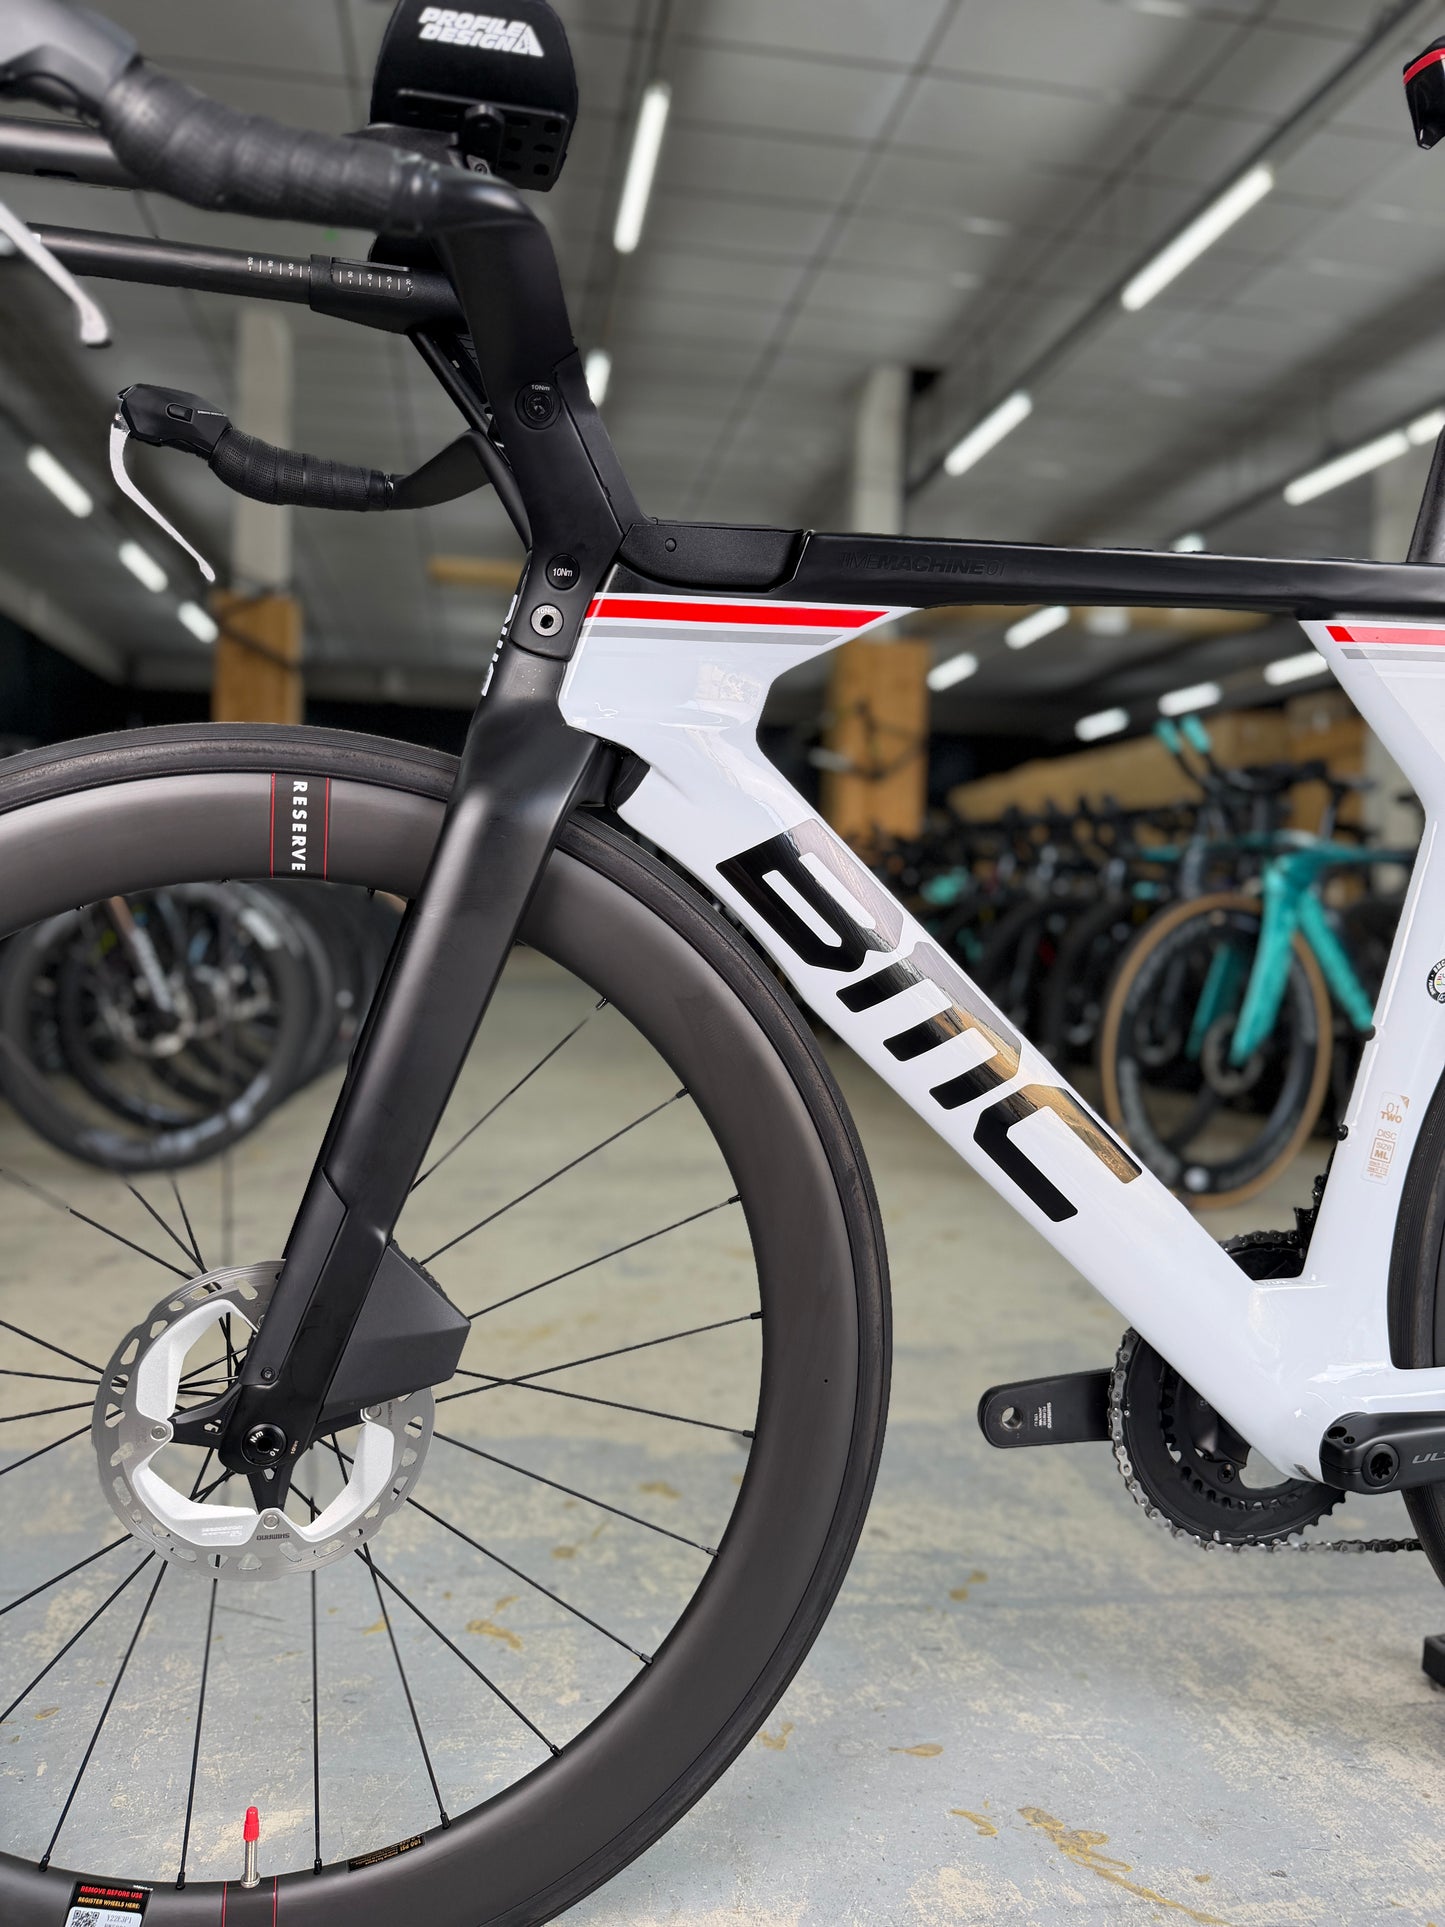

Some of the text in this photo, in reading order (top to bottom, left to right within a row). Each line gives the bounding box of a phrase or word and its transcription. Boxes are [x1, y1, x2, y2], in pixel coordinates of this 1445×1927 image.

[418, 6, 527, 38] PROFILE
[418, 23, 521, 52] DESIGN
[552, 567, 573, 577] 10Nm
[291, 780, 309, 871] RESERVE
[715, 818, 1143, 1223] BMC
[1386, 1102, 1400, 1115] 01
[1381, 1110, 1403, 1124] TWO
[1376, 1128, 1398, 1141] DISC
[1374, 1149, 1389, 1161] ML
[1411, 1451, 1445, 1464] UL
[256, 1532, 291, 1541] SHIMANO
[80, 1885, 106, 1895] REMOVE
[106, 1888, 130, 1898] BEFORE
[130, 1891, 144, 1899] USE
[77, 1896, 103, 1905] REGISTER
[103, 1899, 125, 1908] WHEELS
